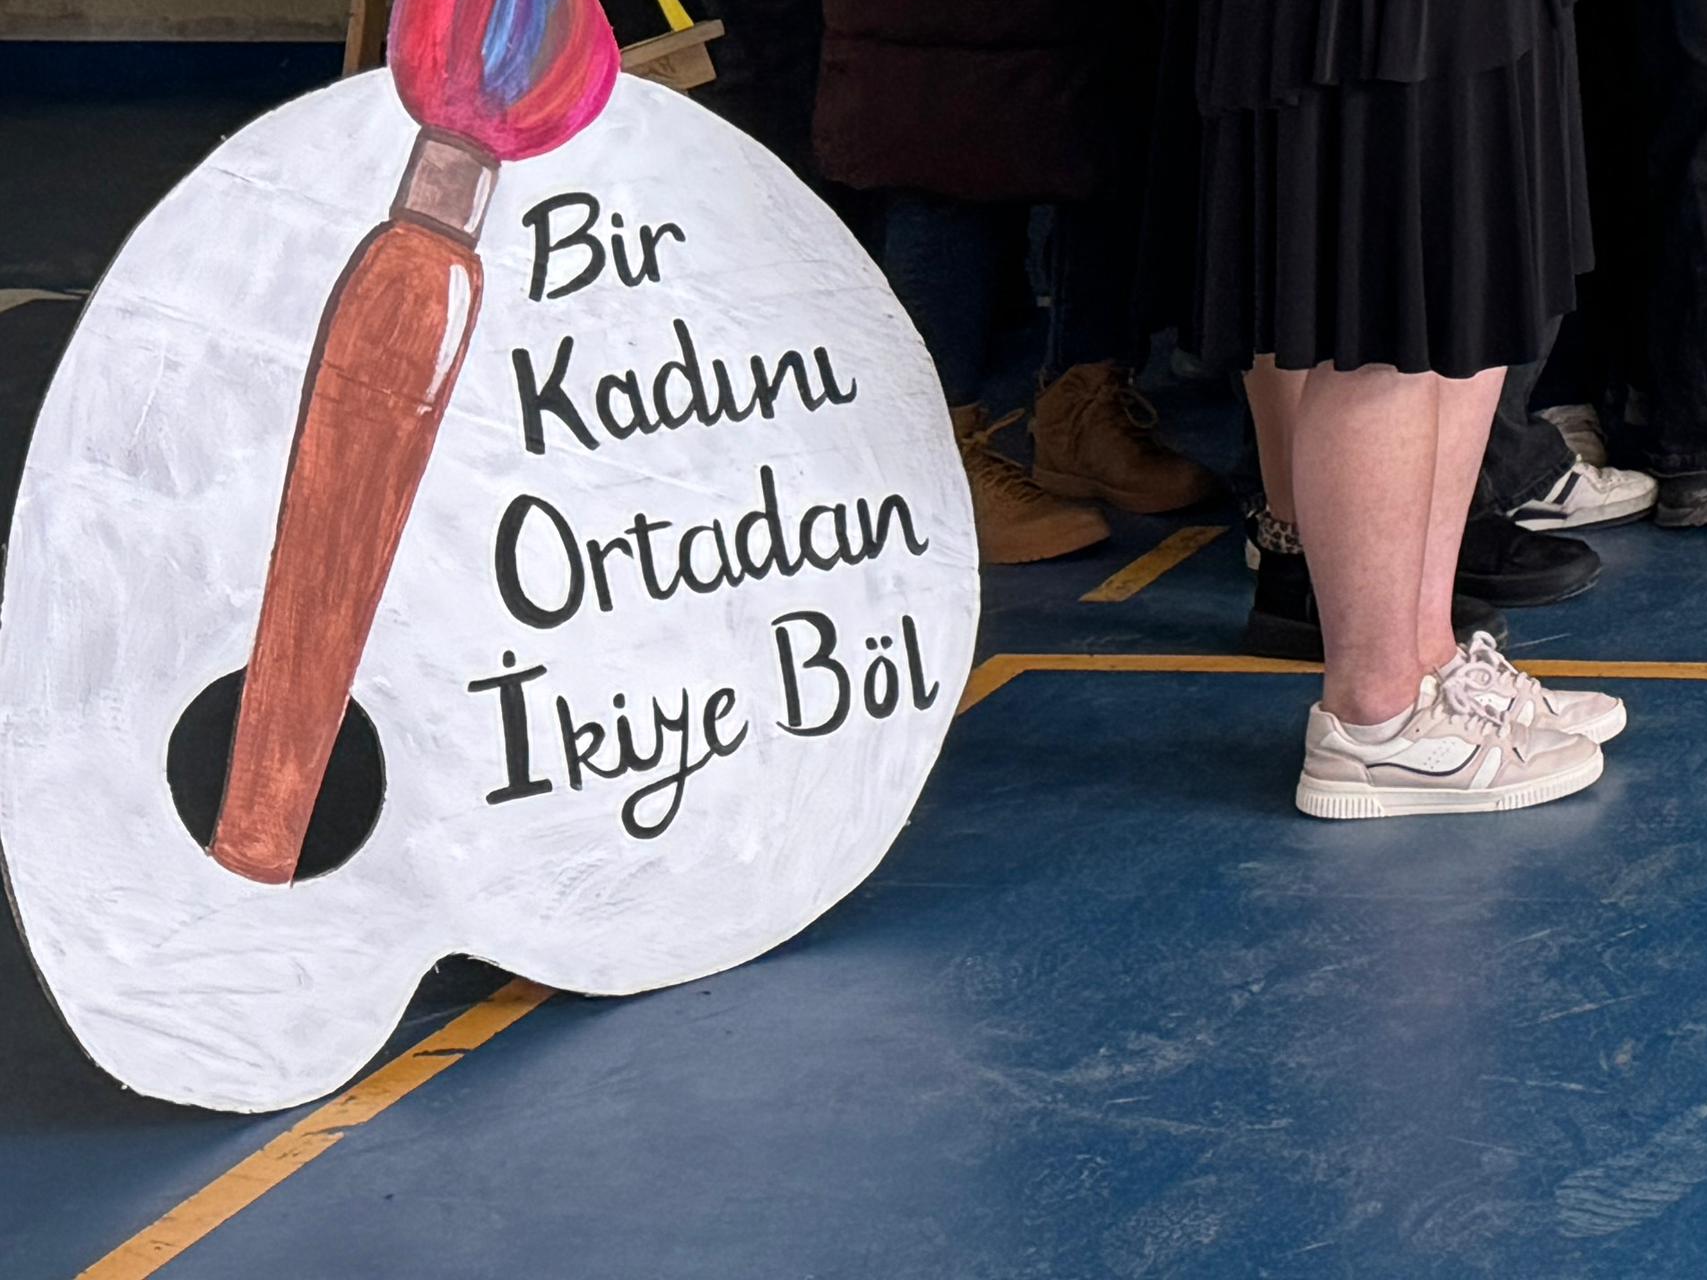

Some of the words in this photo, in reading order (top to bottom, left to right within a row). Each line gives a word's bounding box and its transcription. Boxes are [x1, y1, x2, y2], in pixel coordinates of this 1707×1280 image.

[522, 190, 687, 303] Bir
[511, 317, 858, 456] Kadını
[494, 464, 930, 630] Ortadan
[467, 649, 749, 840] İkiye
[771, 609, 940, 738] Böl
